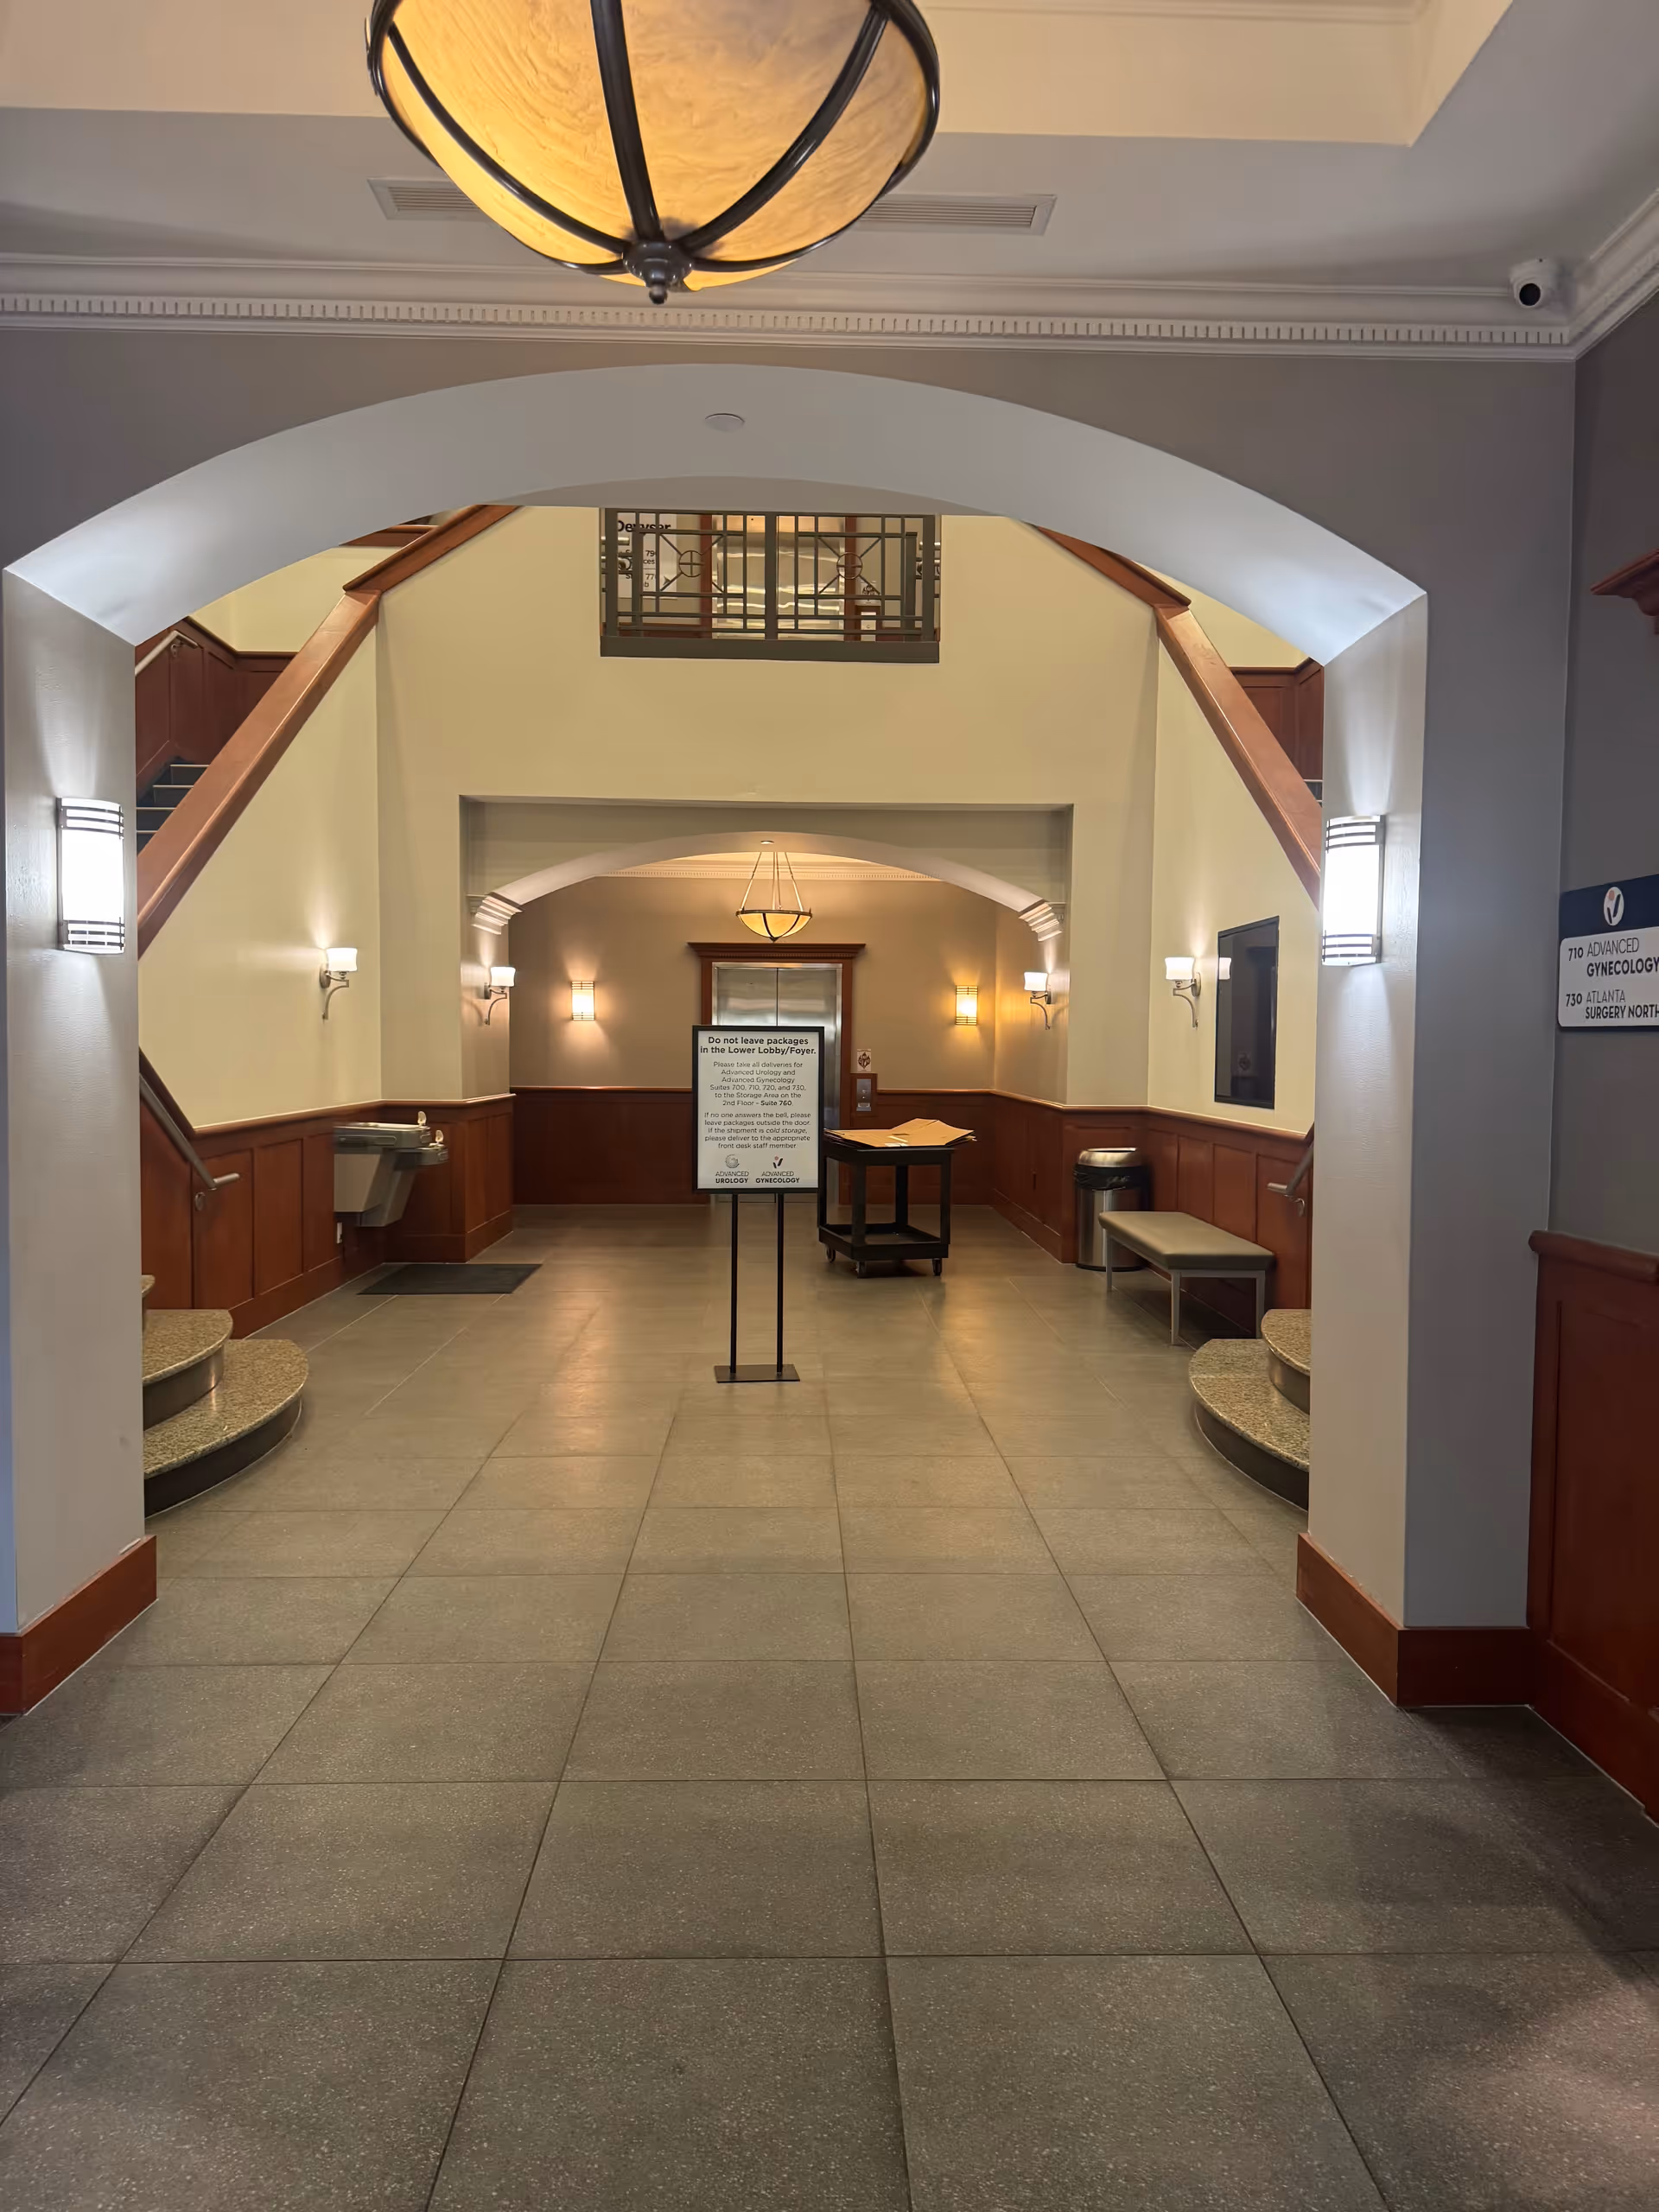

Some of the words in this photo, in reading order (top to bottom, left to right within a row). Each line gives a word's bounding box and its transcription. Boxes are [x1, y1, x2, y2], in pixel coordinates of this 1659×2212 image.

[1568, 947, 1583, 961] 710
[1587, 938, 1639, 957] ADVANCED
[1587, 956, 1659, 977] GYNECOLOGY
[1566, 993, 1582, 1006] 730
[1586, 989, 1625, 1003] ATLANTA
[1585, 1006, 1626, 1019] SURGERY
[767, 1037, 808, 1046] packages
[758, 1046, 816, 1055] Lobby/Foyer.
